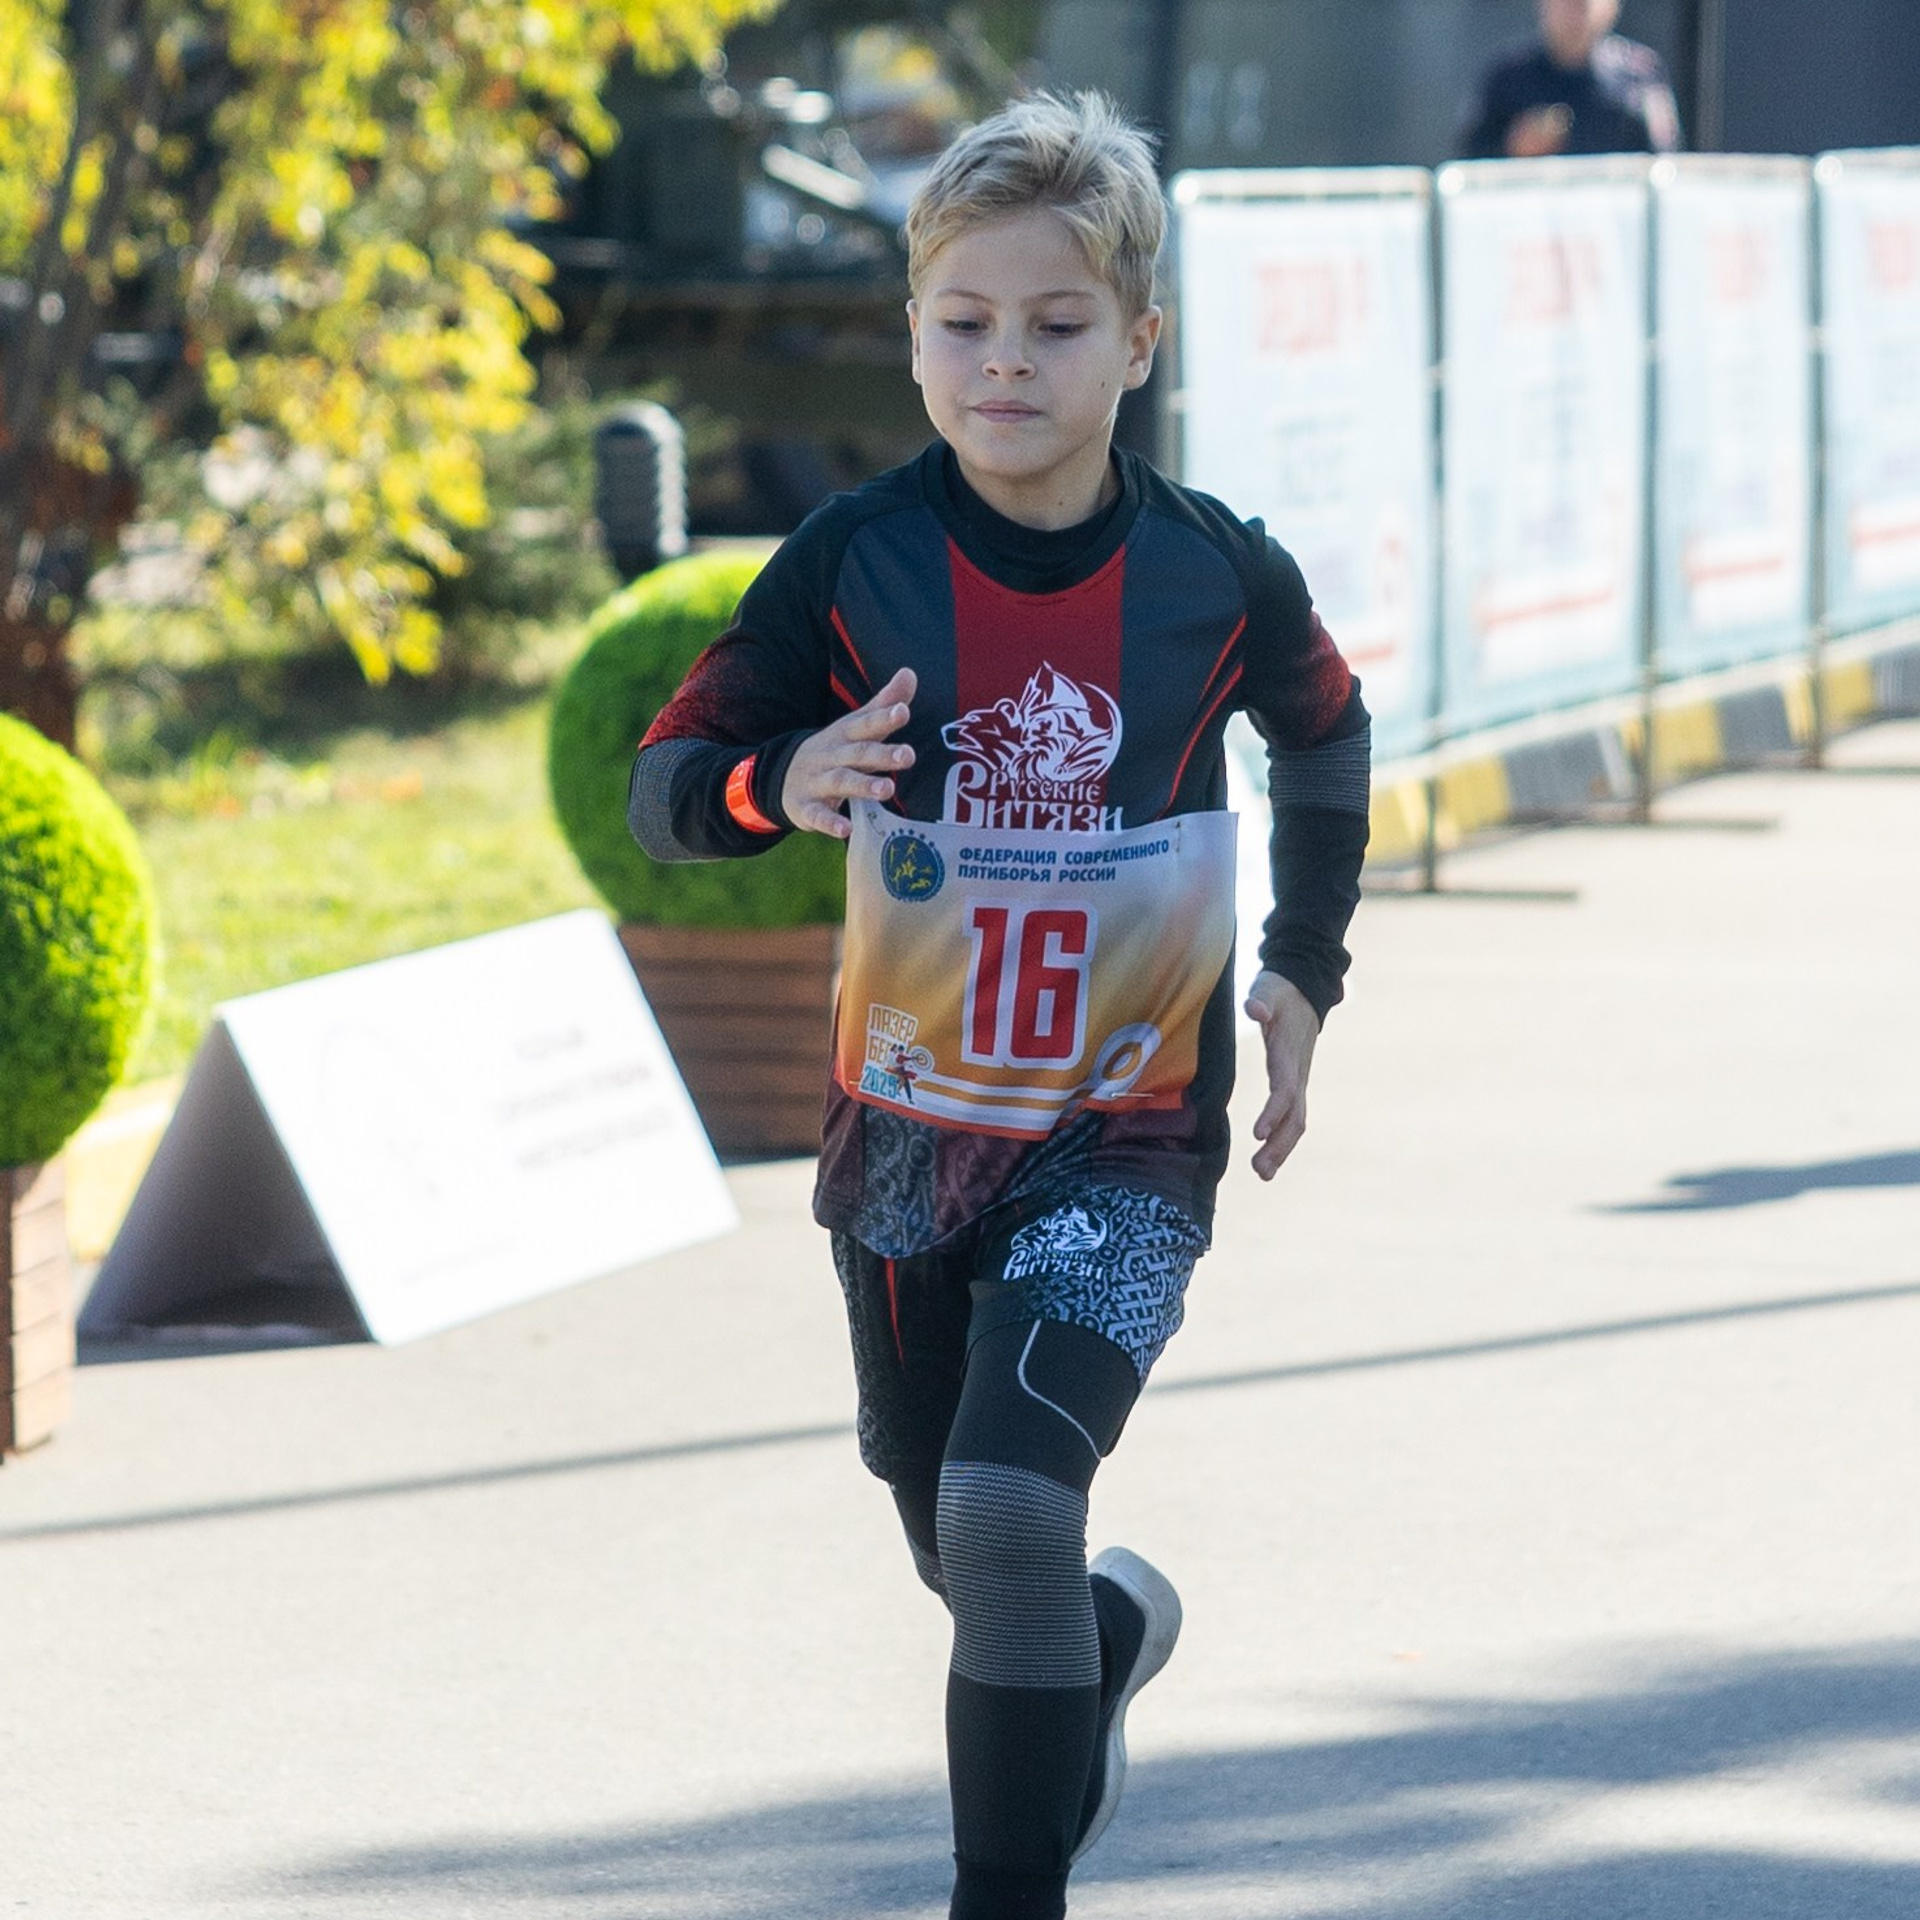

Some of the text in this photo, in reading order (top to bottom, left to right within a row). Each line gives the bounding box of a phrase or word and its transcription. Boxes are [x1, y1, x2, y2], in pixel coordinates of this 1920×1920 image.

[958, 839, 1170, 866] ФЕДЕРАЦИЯ СОВРЕМЕННОГО
[957, 864, 1117, 883] ПЯТИБОРЬЯ РОССИИ
[969, 904, 1091, 1061] 16
[870, 1006, 917, 1043] ЛАЗЕР
[860, 1065, 899, 1100] 2025
